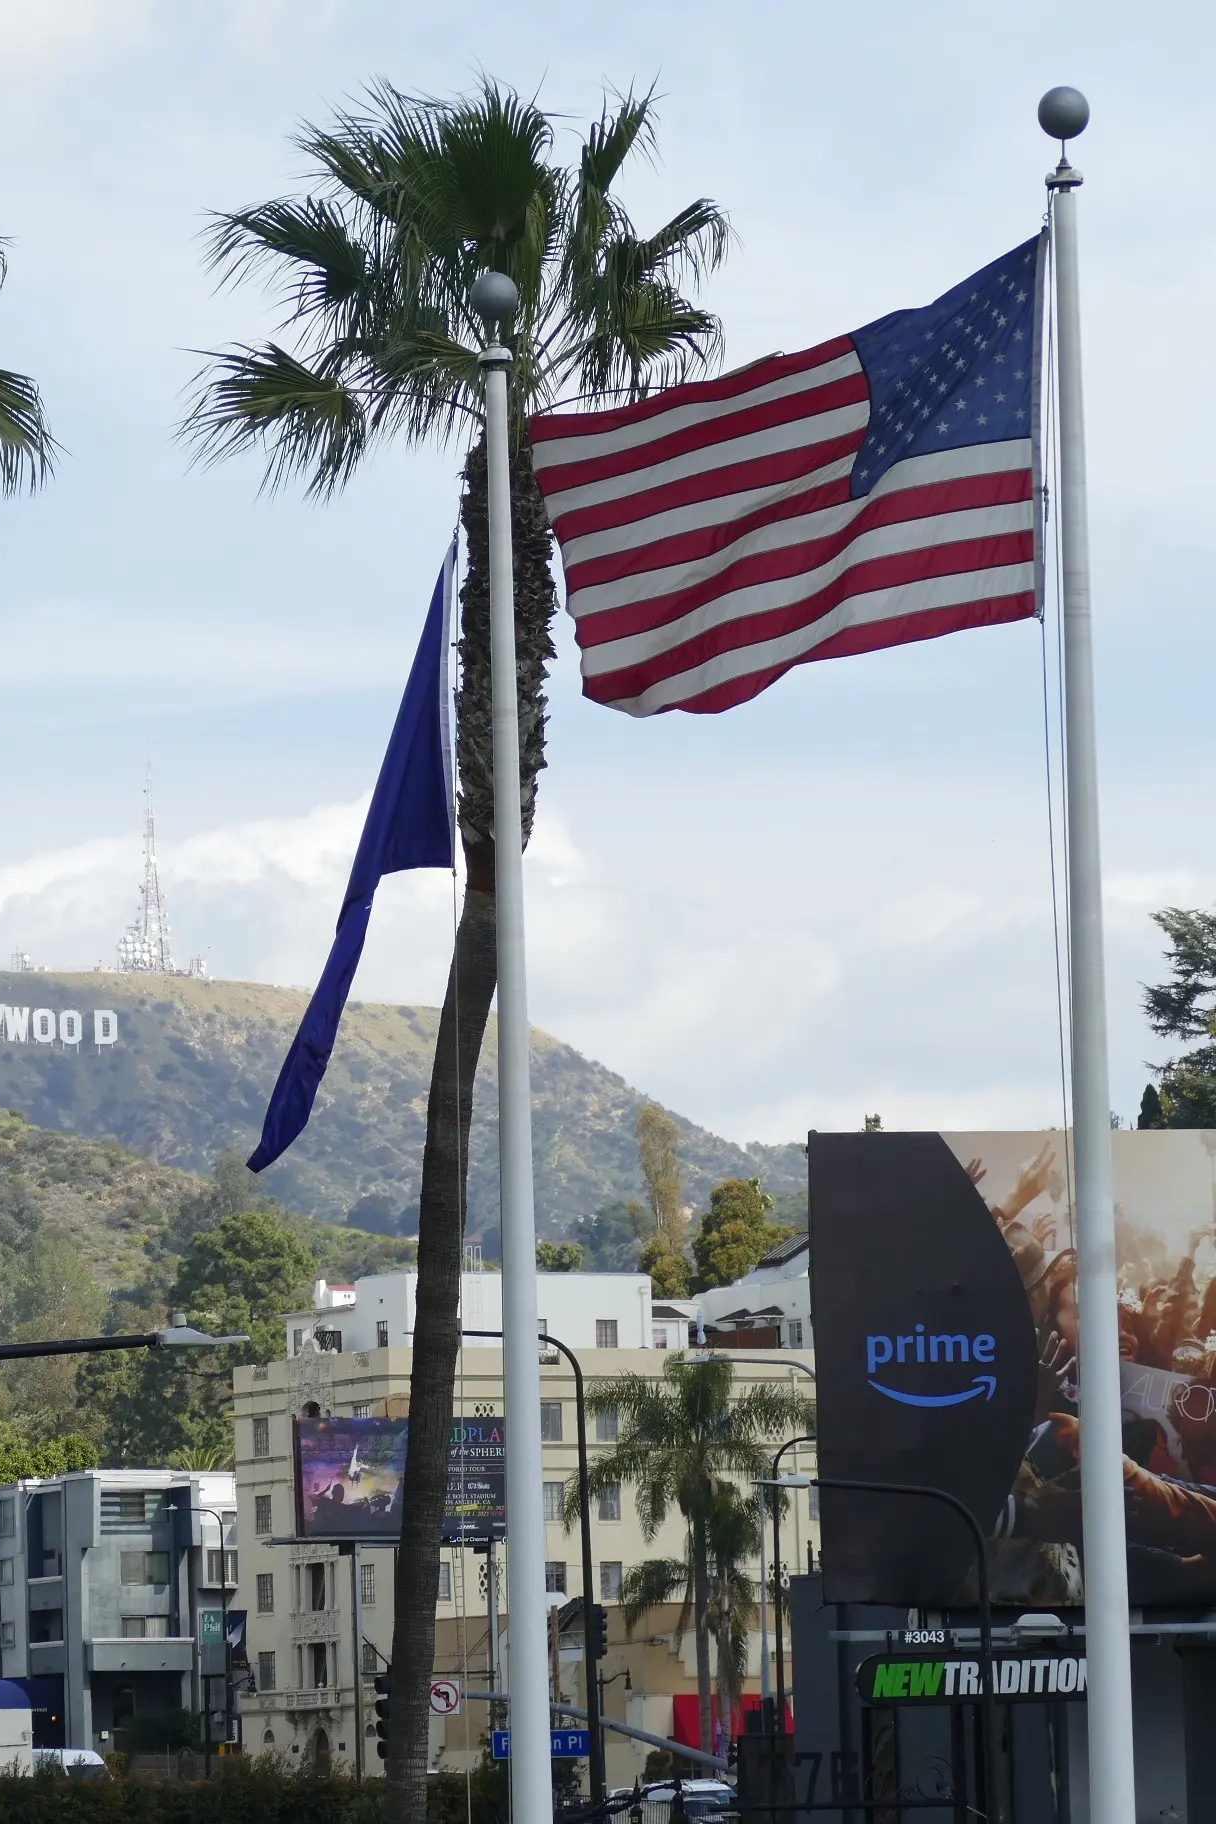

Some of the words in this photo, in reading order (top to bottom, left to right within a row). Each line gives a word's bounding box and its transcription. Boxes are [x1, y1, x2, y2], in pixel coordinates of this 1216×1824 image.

[867, 1324, 996, 1373] prime
[451, 1447, 458, 1457] of
[470, 1448, 504, 1457] SPHER
[204, 1614, 214, 1622] LA
[204, 1622, 221, 1632] Phil
[904, 1631, 945, 1643] #3043
[568, 1736, 582, 1749] Pl
